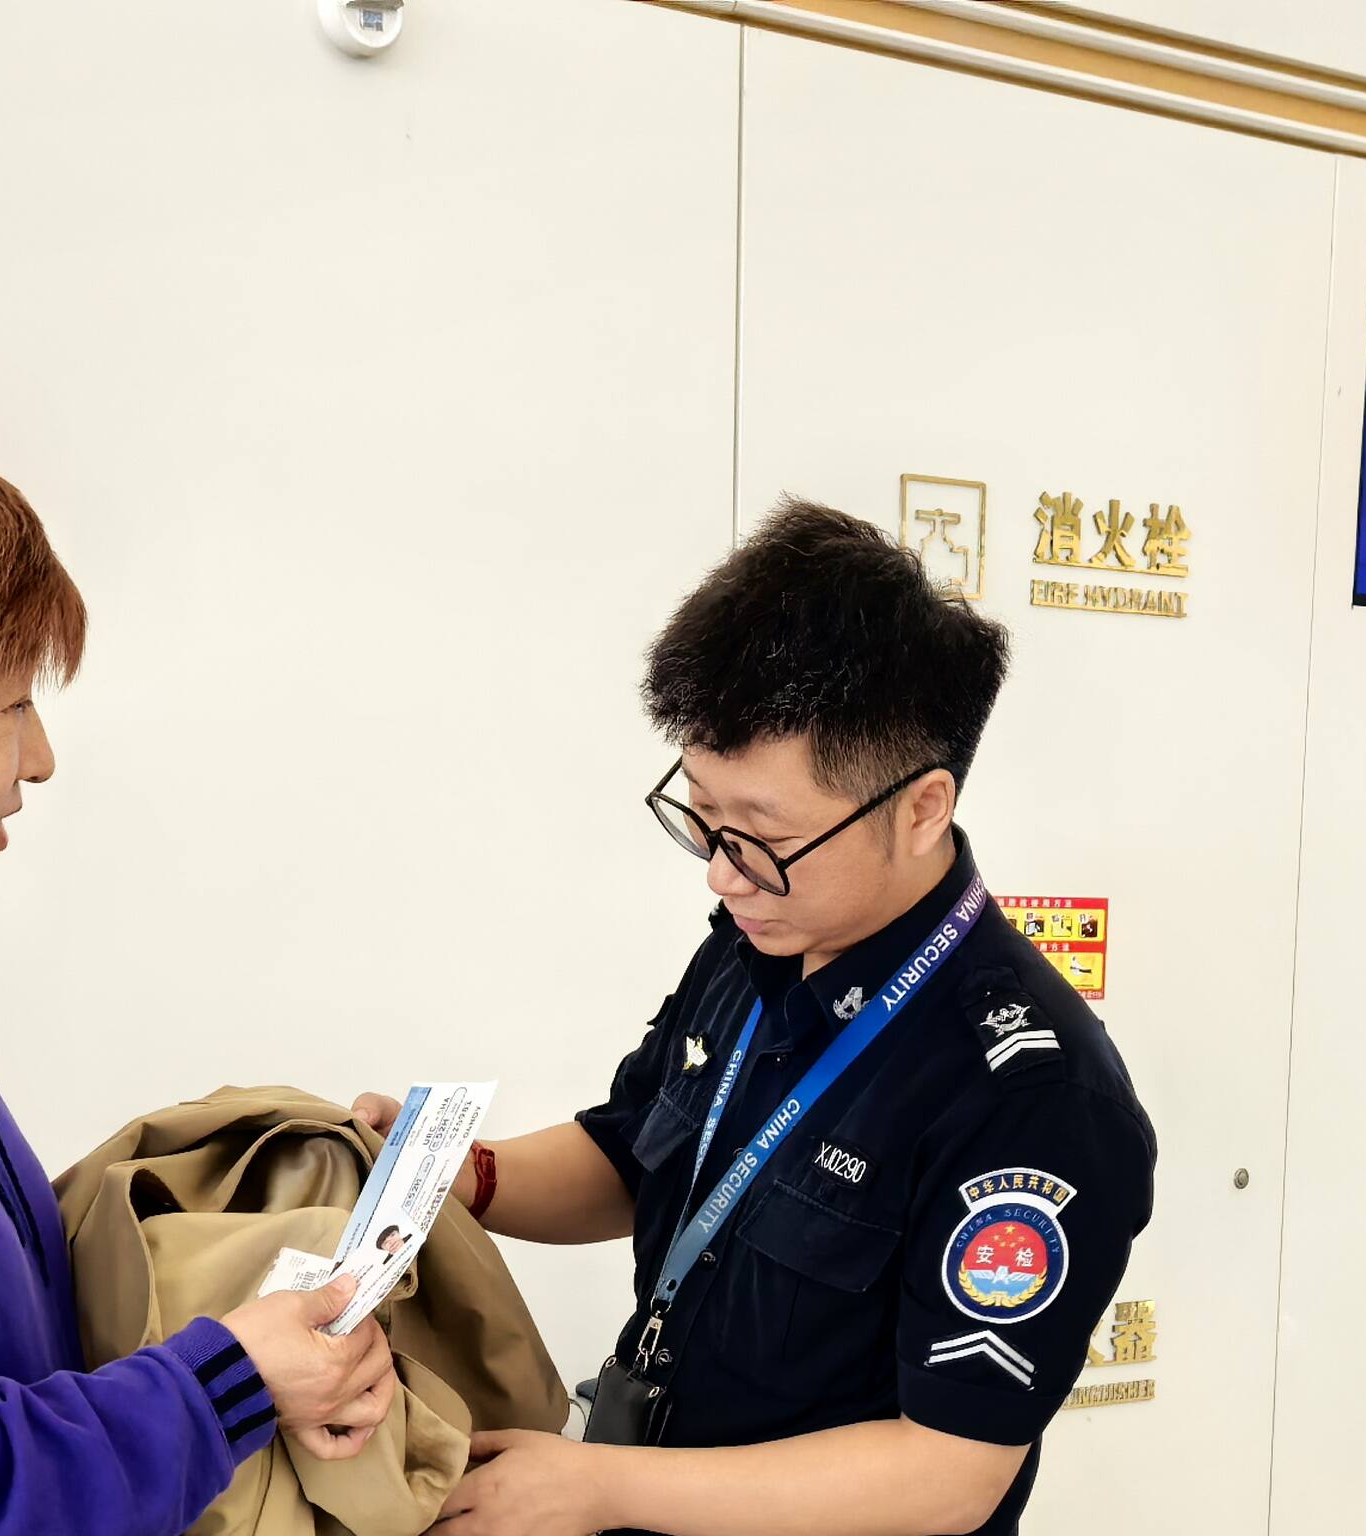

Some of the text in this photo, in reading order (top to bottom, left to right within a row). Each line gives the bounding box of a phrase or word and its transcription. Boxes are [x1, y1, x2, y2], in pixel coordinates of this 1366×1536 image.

[1033, 491, 1192, 573] 消火栓
[882, 923, 958, 1011] SECURITY
[714, 1050, 742, 1108] CHINA
[698, 1099, 800, 1233] CHINA SECURITY
[814, 1141, 867, 1183] XJ0290
[969, 1174, 1069, 1204] 中华人民共和国
[957, 1208, 1060, 1254] CHINA SECURITY
[975, 1245, 1034, 1267] 安检
